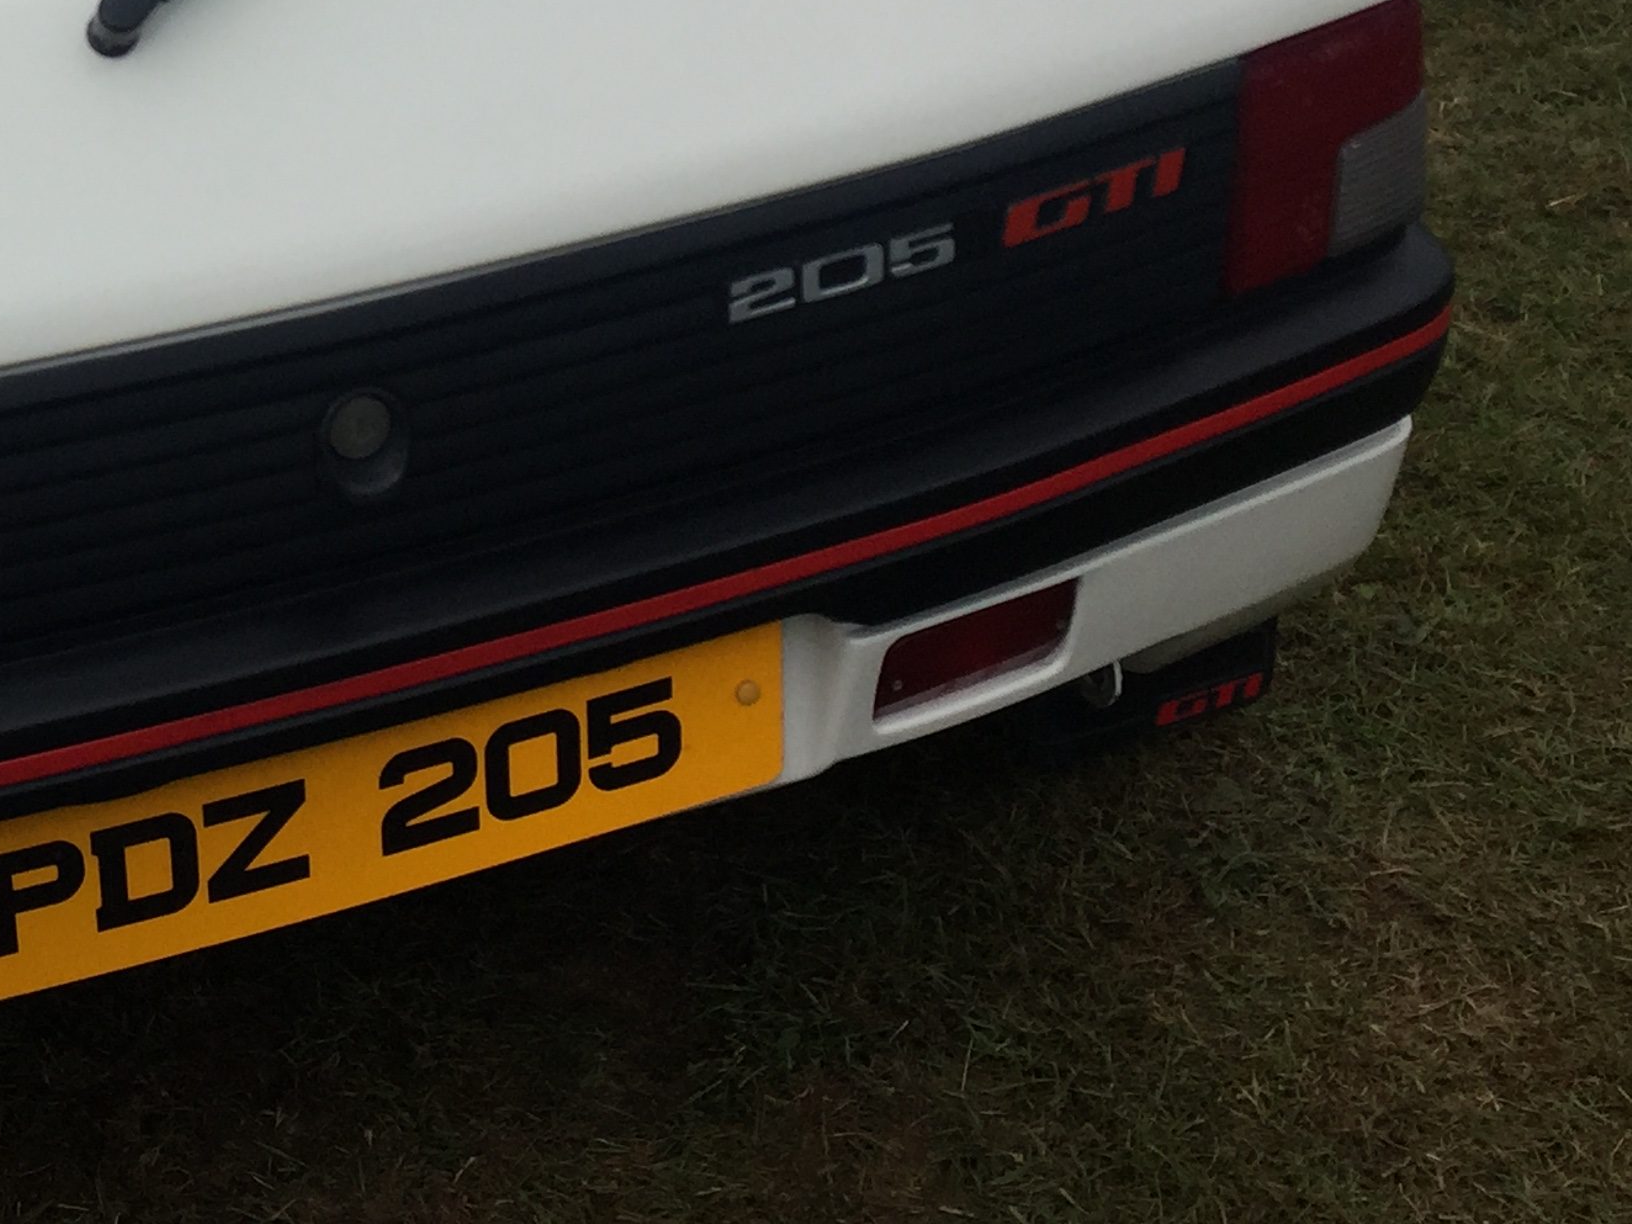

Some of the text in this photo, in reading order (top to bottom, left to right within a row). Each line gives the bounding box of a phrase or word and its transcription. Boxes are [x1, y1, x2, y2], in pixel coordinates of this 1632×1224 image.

[728, 147, 1186, 324] 205 GTI
[378, 676, 683, 858] 205
[1153, 671, 1264, 728] GTI
